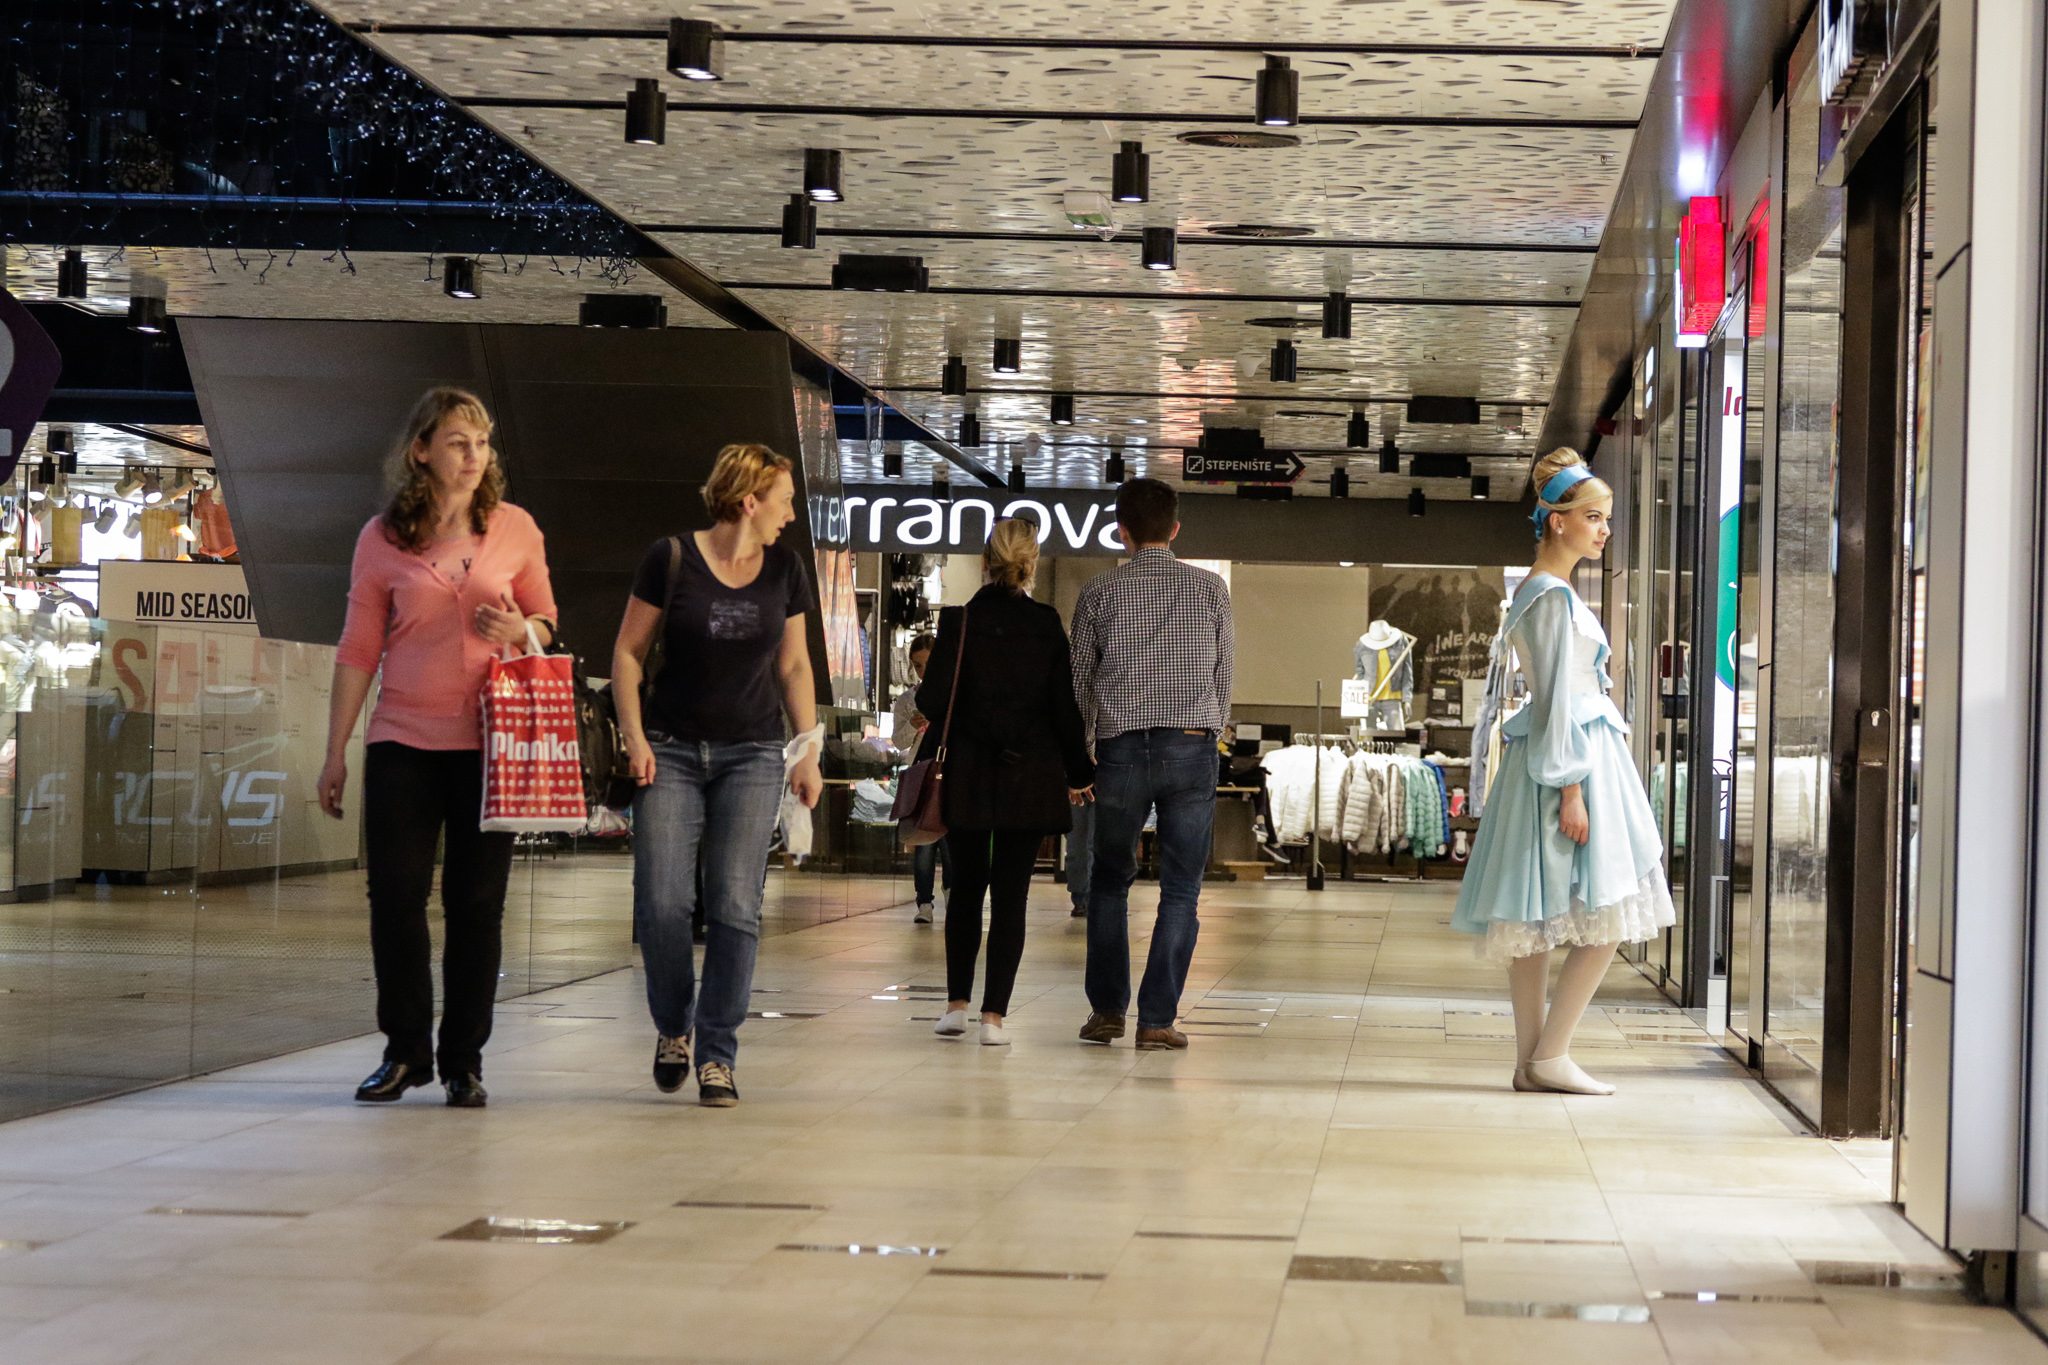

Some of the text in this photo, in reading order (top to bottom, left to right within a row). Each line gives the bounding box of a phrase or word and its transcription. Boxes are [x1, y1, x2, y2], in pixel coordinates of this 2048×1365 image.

[1206, 458, 1272, 471] STEPENIŠTE
[136, 591, 174, 617] MID
[1343, 691, 1369, 705] SALE
[491, 732, 579, 762] Planika
